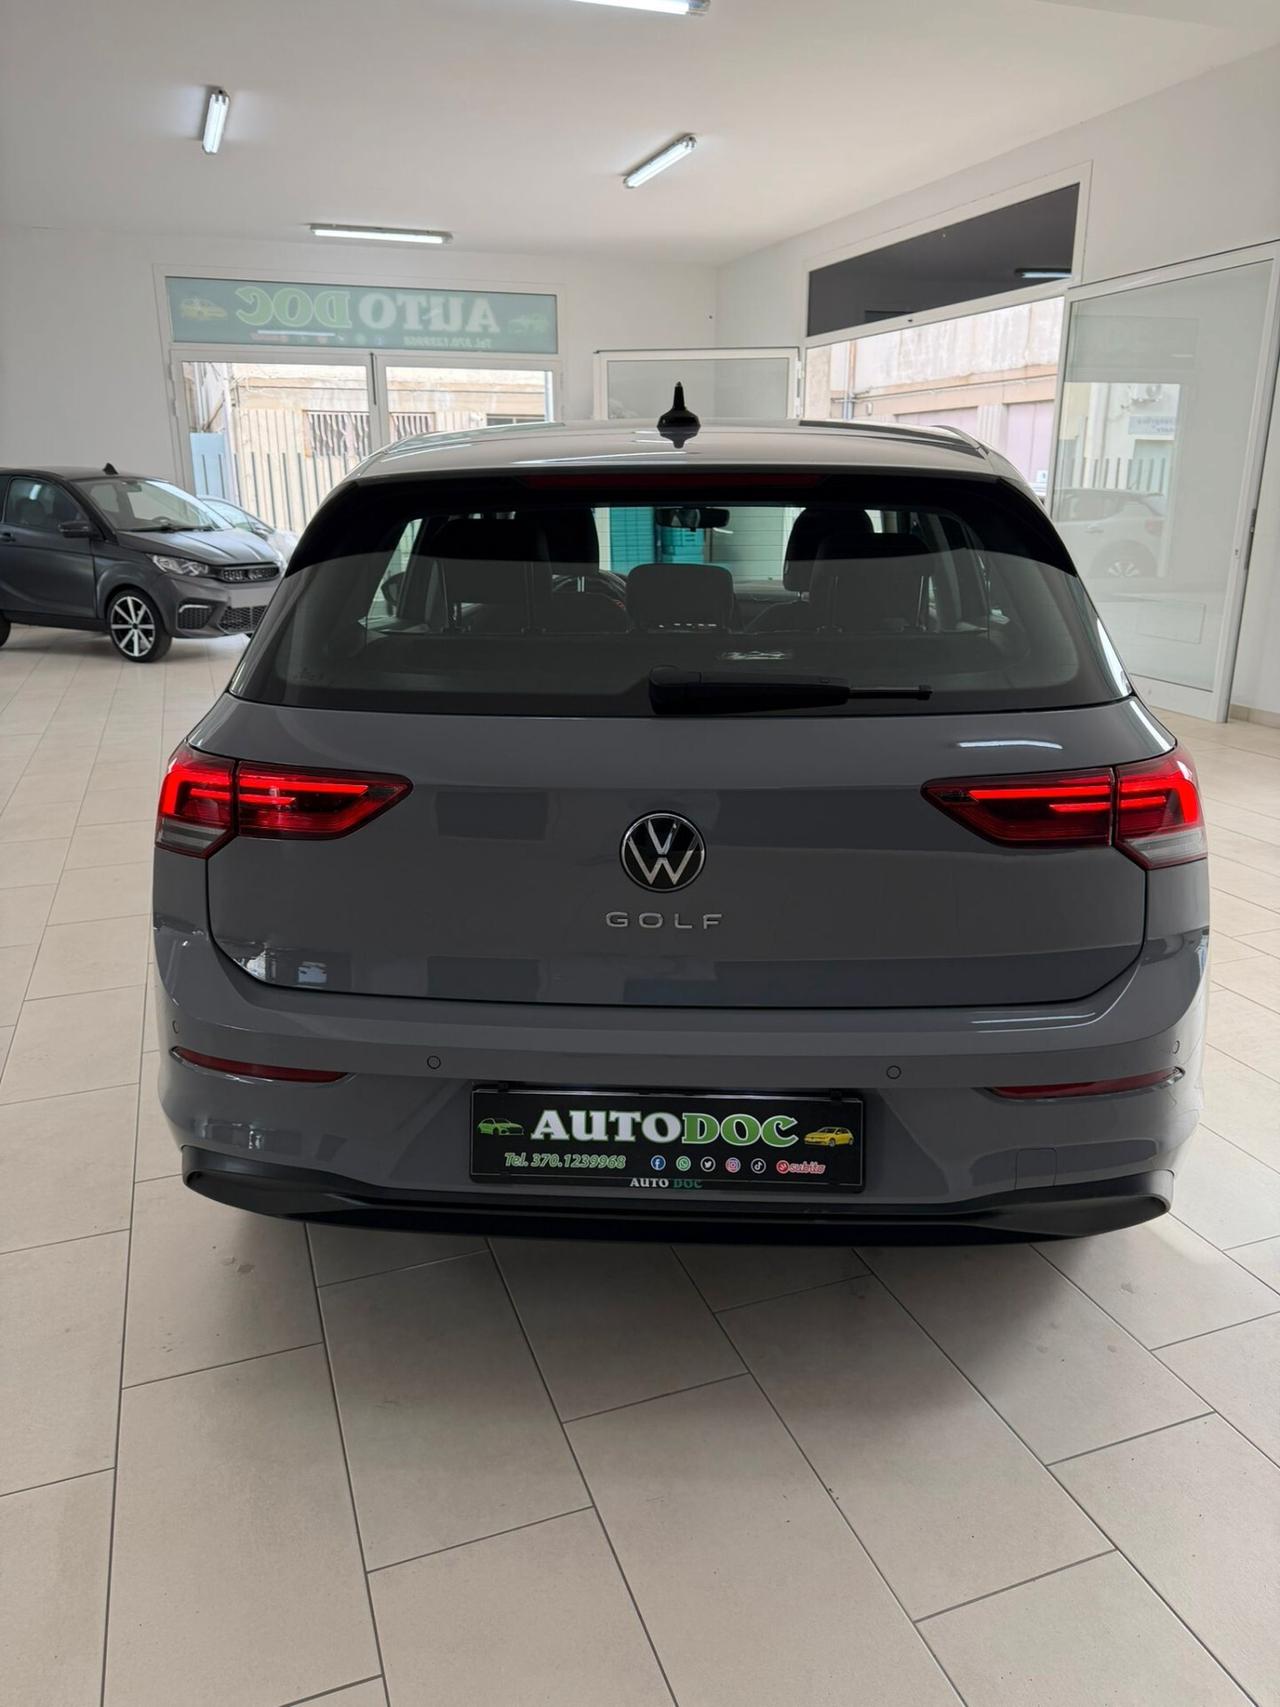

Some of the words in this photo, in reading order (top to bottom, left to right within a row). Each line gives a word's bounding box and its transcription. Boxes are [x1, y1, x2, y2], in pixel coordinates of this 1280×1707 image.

[605, 911, 722, 929] GOLF
[505, 1153, 528, 1167] Tel.
[531, 1153, 626, 1169] 370.1239968
[629, 1177, 669, 1188] AUTO
[673, 1178, 703, 1189] DOC
